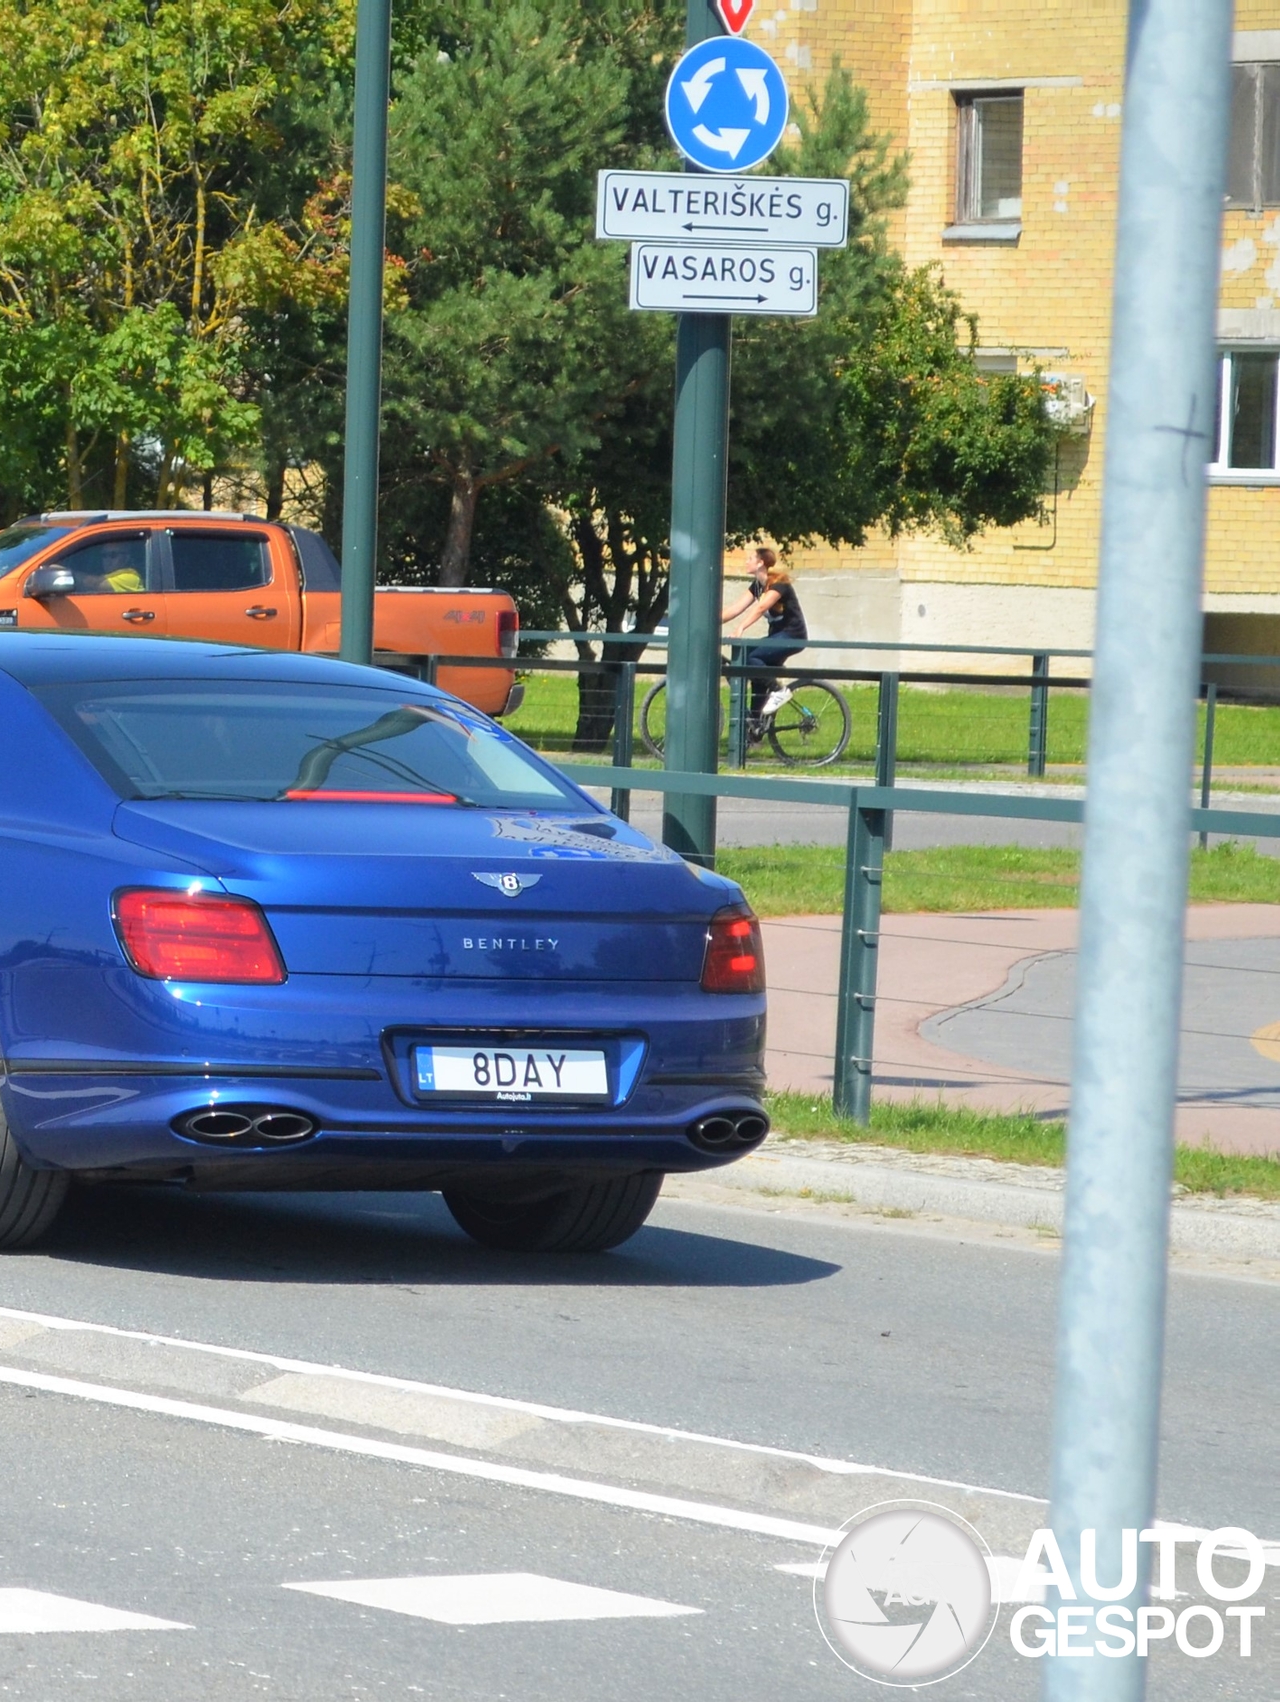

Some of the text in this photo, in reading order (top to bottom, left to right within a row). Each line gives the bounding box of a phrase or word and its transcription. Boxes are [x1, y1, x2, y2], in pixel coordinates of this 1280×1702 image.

[612, 183, 838, 227] VALTERIŠKĖS g.
[642, 254, 811, 291] VASAROS g.
[463, 937, 559, 950] BENTLEY
[419, 1072, 433, 1083] LT
[473, 1052, 566, 1088] 8DAY
